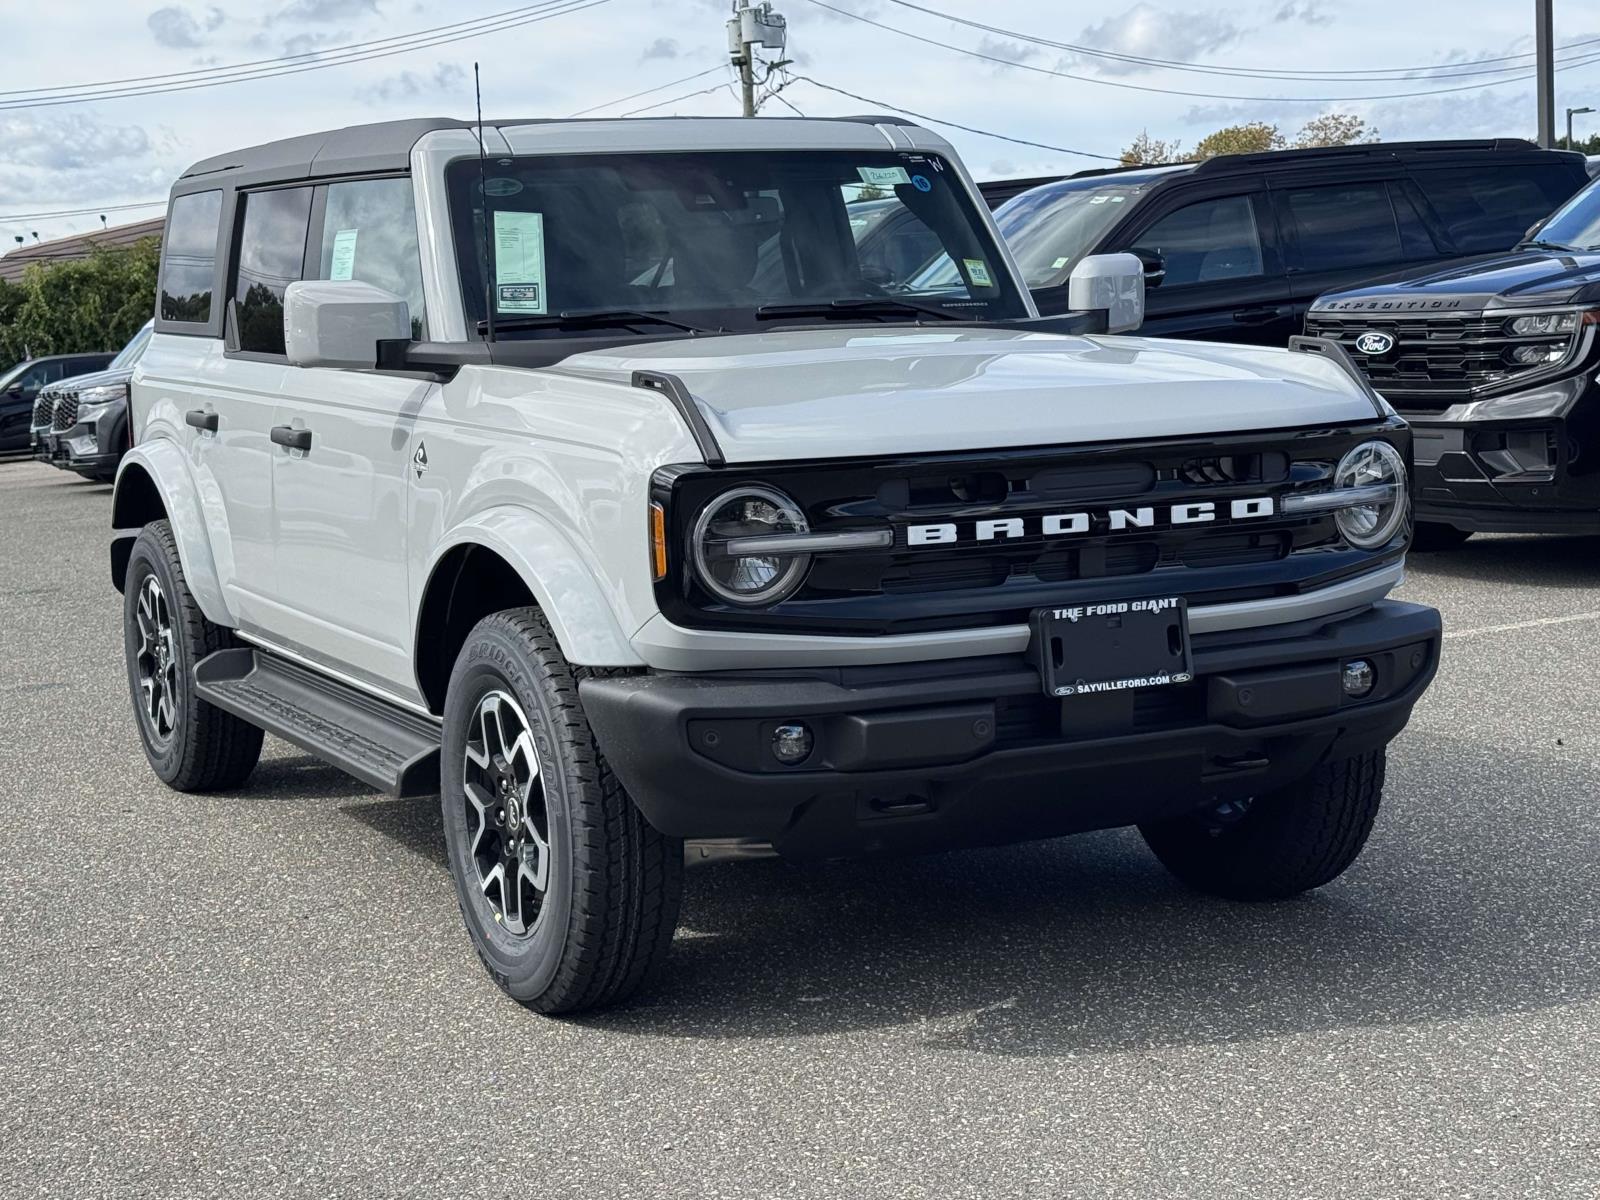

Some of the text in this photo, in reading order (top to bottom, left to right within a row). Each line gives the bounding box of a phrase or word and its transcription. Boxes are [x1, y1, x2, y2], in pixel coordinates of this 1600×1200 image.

[915, 178, 929, 190] 16
[1327, 299, 1461, 310] EXPEDITION
[1362, 336, 1386, 351] Ford
[907, 497, 1274, 546] BRONCO
[1052, 597, 1179, 620] THE FORD GIANT
[1077, 675, 1170, 694] SAYVILLEFORD.COM
